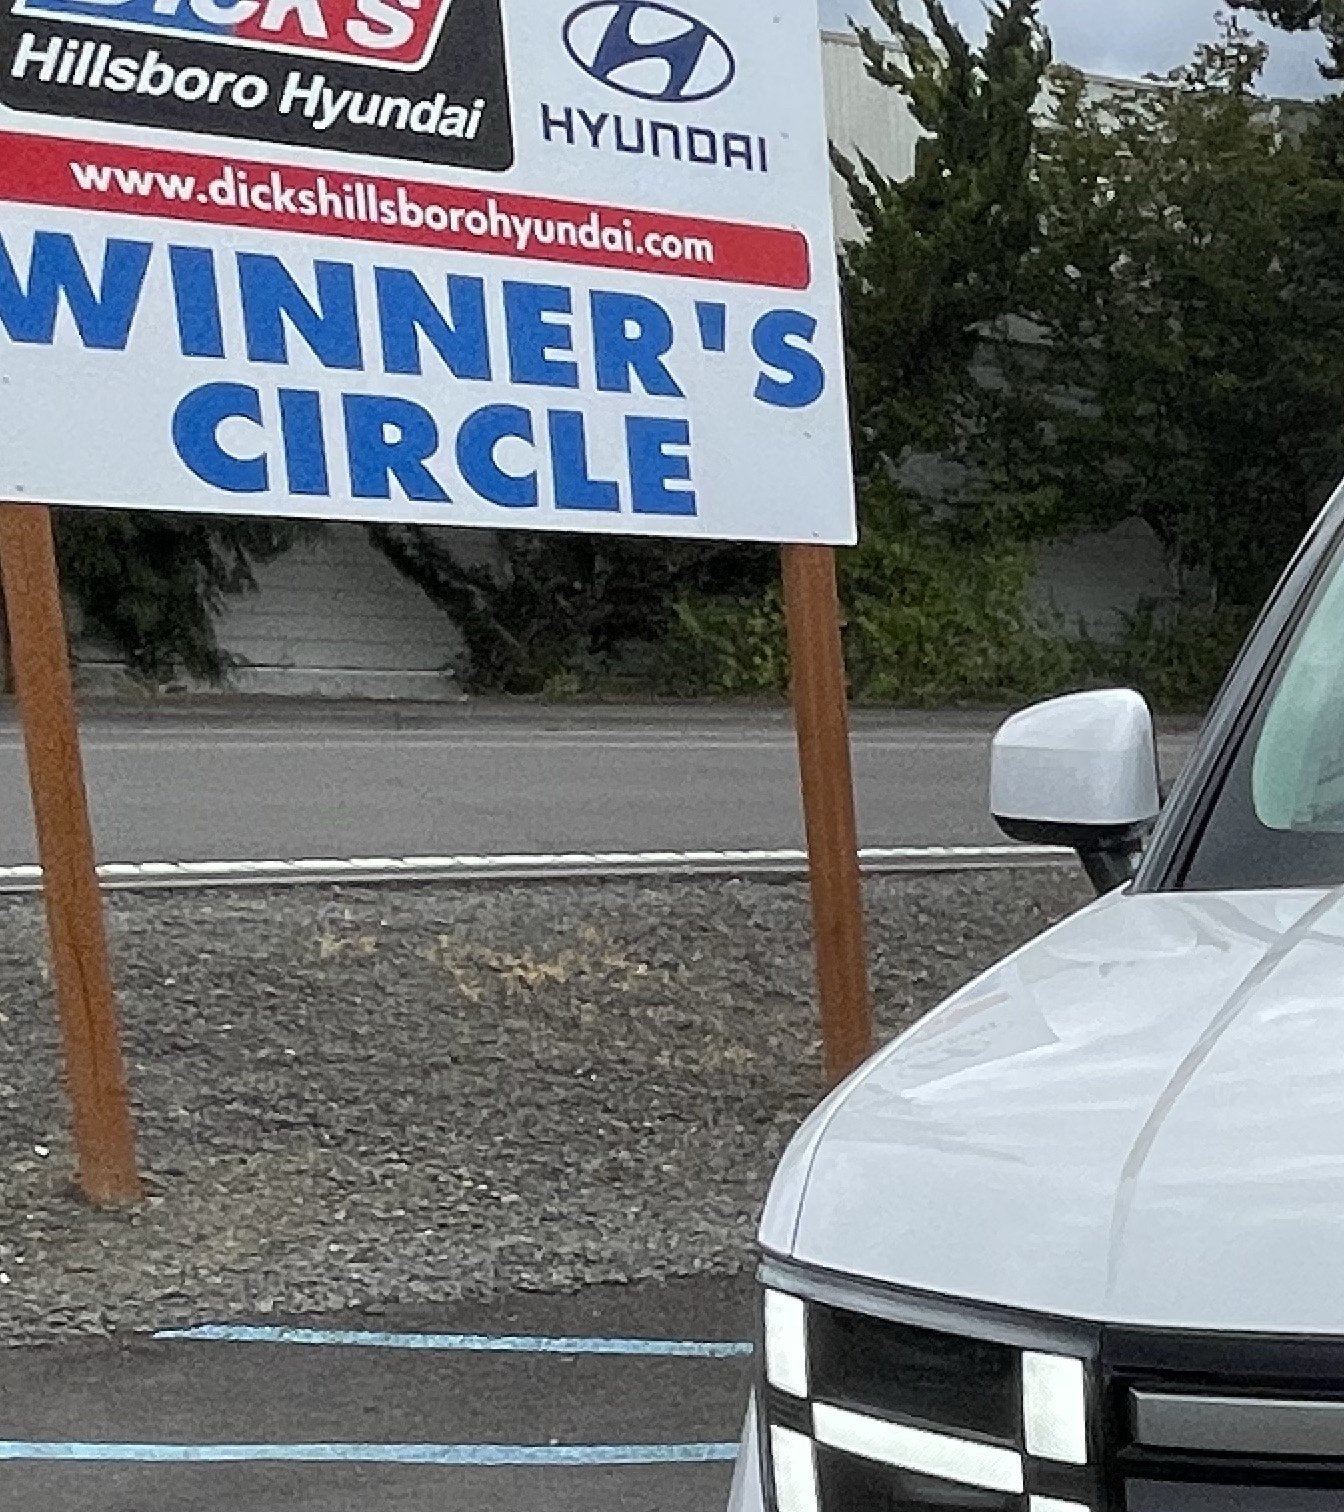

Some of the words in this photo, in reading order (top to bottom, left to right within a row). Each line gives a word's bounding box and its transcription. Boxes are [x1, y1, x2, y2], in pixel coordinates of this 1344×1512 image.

[11, 32, 270, 108] Hillsboro
[278, 71, 486, 139] Hyundai
[540, 102, 768, 172] HYUNDAI
[70, 158, 715, 264] www.dickshillsborohyundai.com
[0, 230, 826, 409] WINNER'S
[172, 382, 699, 517] CIRCLE
